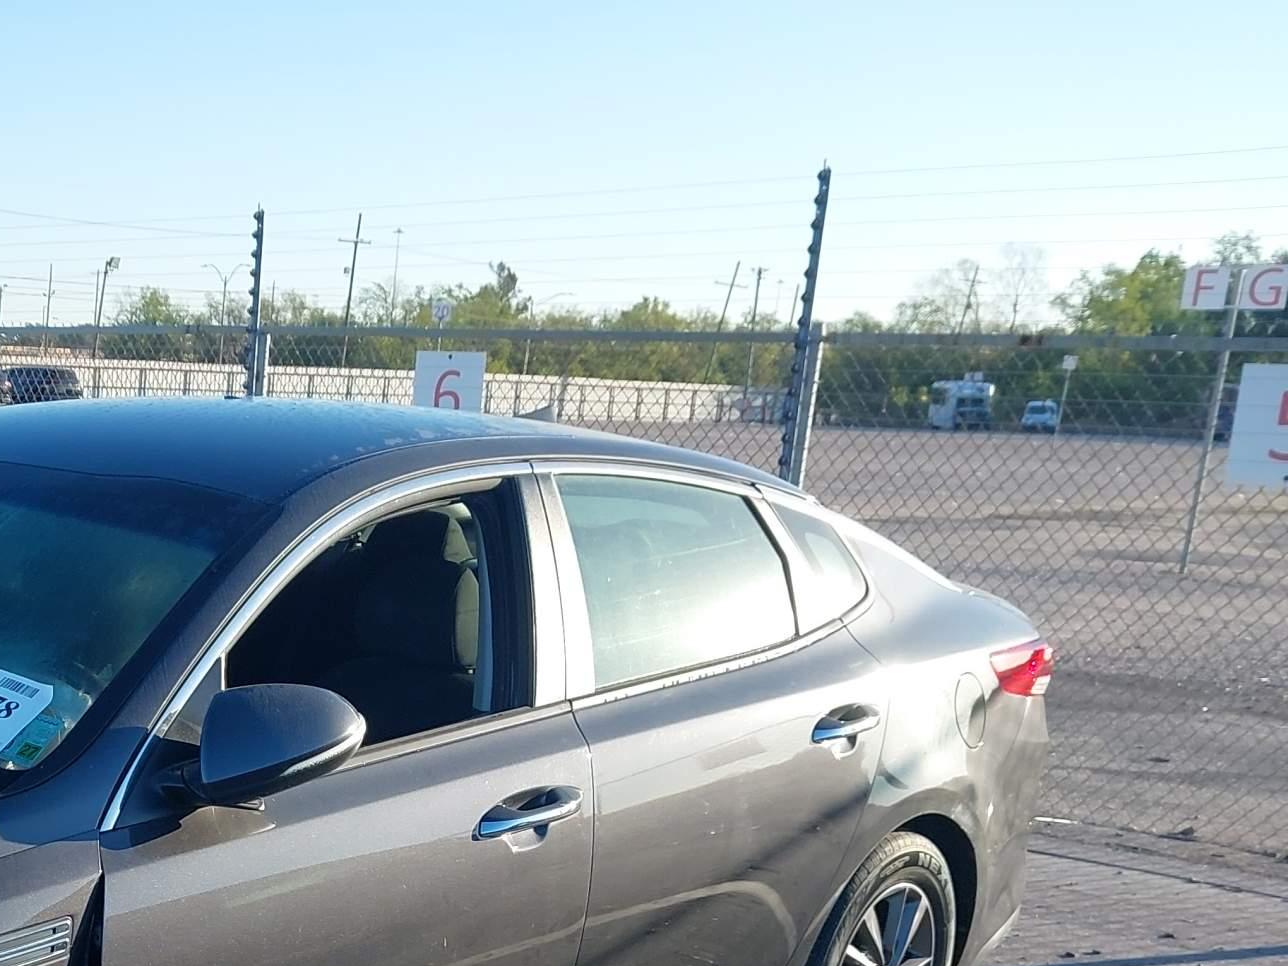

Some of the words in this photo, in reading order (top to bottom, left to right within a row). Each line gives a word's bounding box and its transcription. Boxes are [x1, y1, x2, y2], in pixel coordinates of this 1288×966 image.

[1192, 268, 1219, 307] F
[1247, 267, 1285, 307] G
[433, 368, 461, 410] 6
[18, 744, 43, 759] 27
